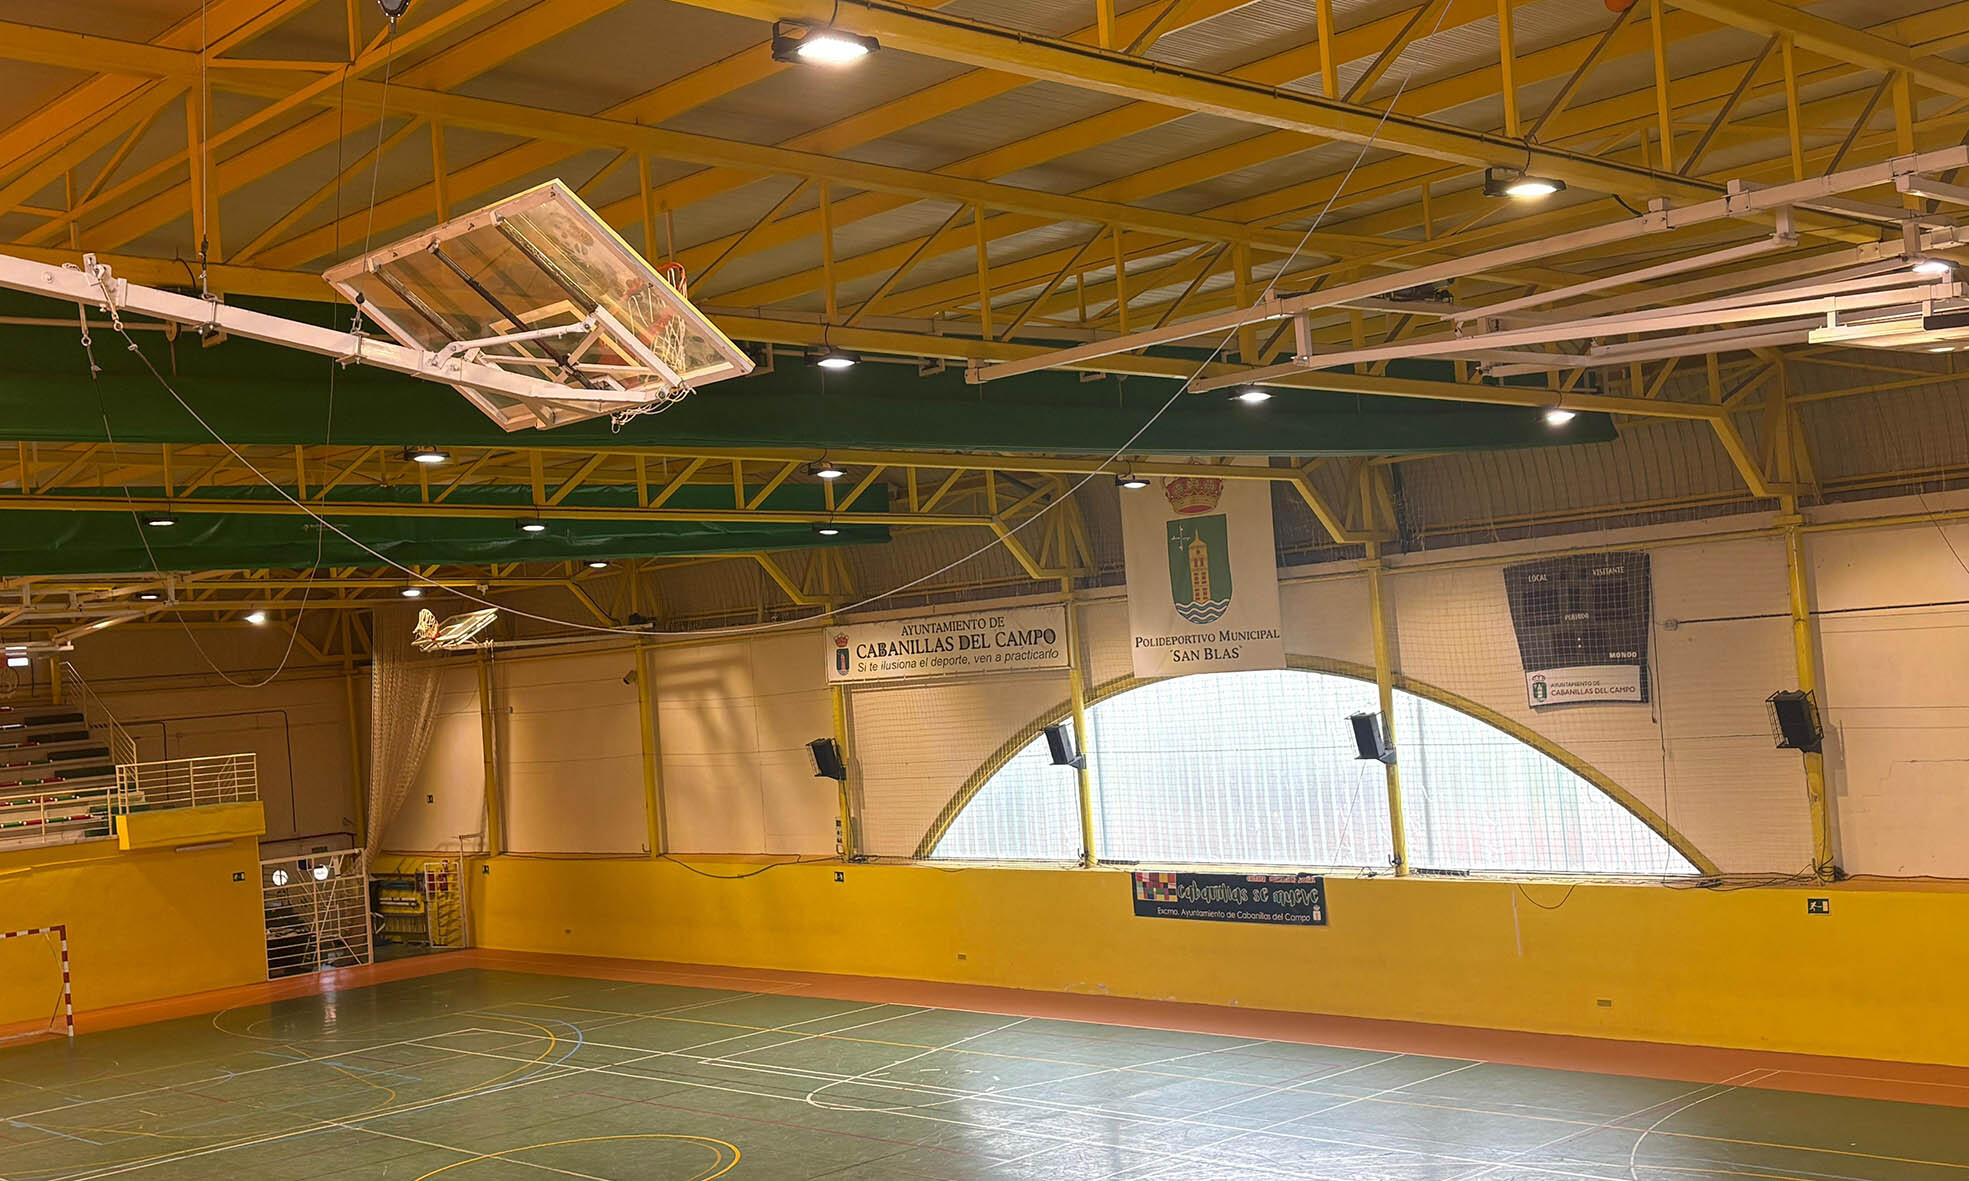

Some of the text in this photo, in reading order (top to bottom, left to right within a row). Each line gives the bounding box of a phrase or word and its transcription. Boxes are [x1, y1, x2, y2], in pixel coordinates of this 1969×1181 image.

[1592, 566, 1625, 576] VISITANTE
[1528, 574, 1548, 583] LOCAL
[901, 616, 1005, 637] AYUNTAMIENTO DE
[856, 628, 1056, 660] CABANILLAS DEL CAMPO
[857, 661, 867, 673] Si
[869, 661, 878, 672] te
[880, 658, 917, 672] ilusiona
[919, 657, 929, 668] el
[974, 654, 992, 665] ven
[995, 654, 1002, 663] a
[1004, 648, 1059, 665] practicarlo
[1609, 651, 1638, 659] MONDO
[1550, 687, 1594, 696] CABANILLAS
[1609, 686, 1636, 694] CAMPO
[1252, 887, 1269, 902] se
[1273, 887, 1319, 907] mueve
[1181, 908, 1225, 918] Ayuntamiento
[1226, 911, 1236, 919] de
[1237, 910, 1271, 920] Cabanillas
[1272, 911, 1283, 920] del
[1284, 912, 1311, 922] Campo
